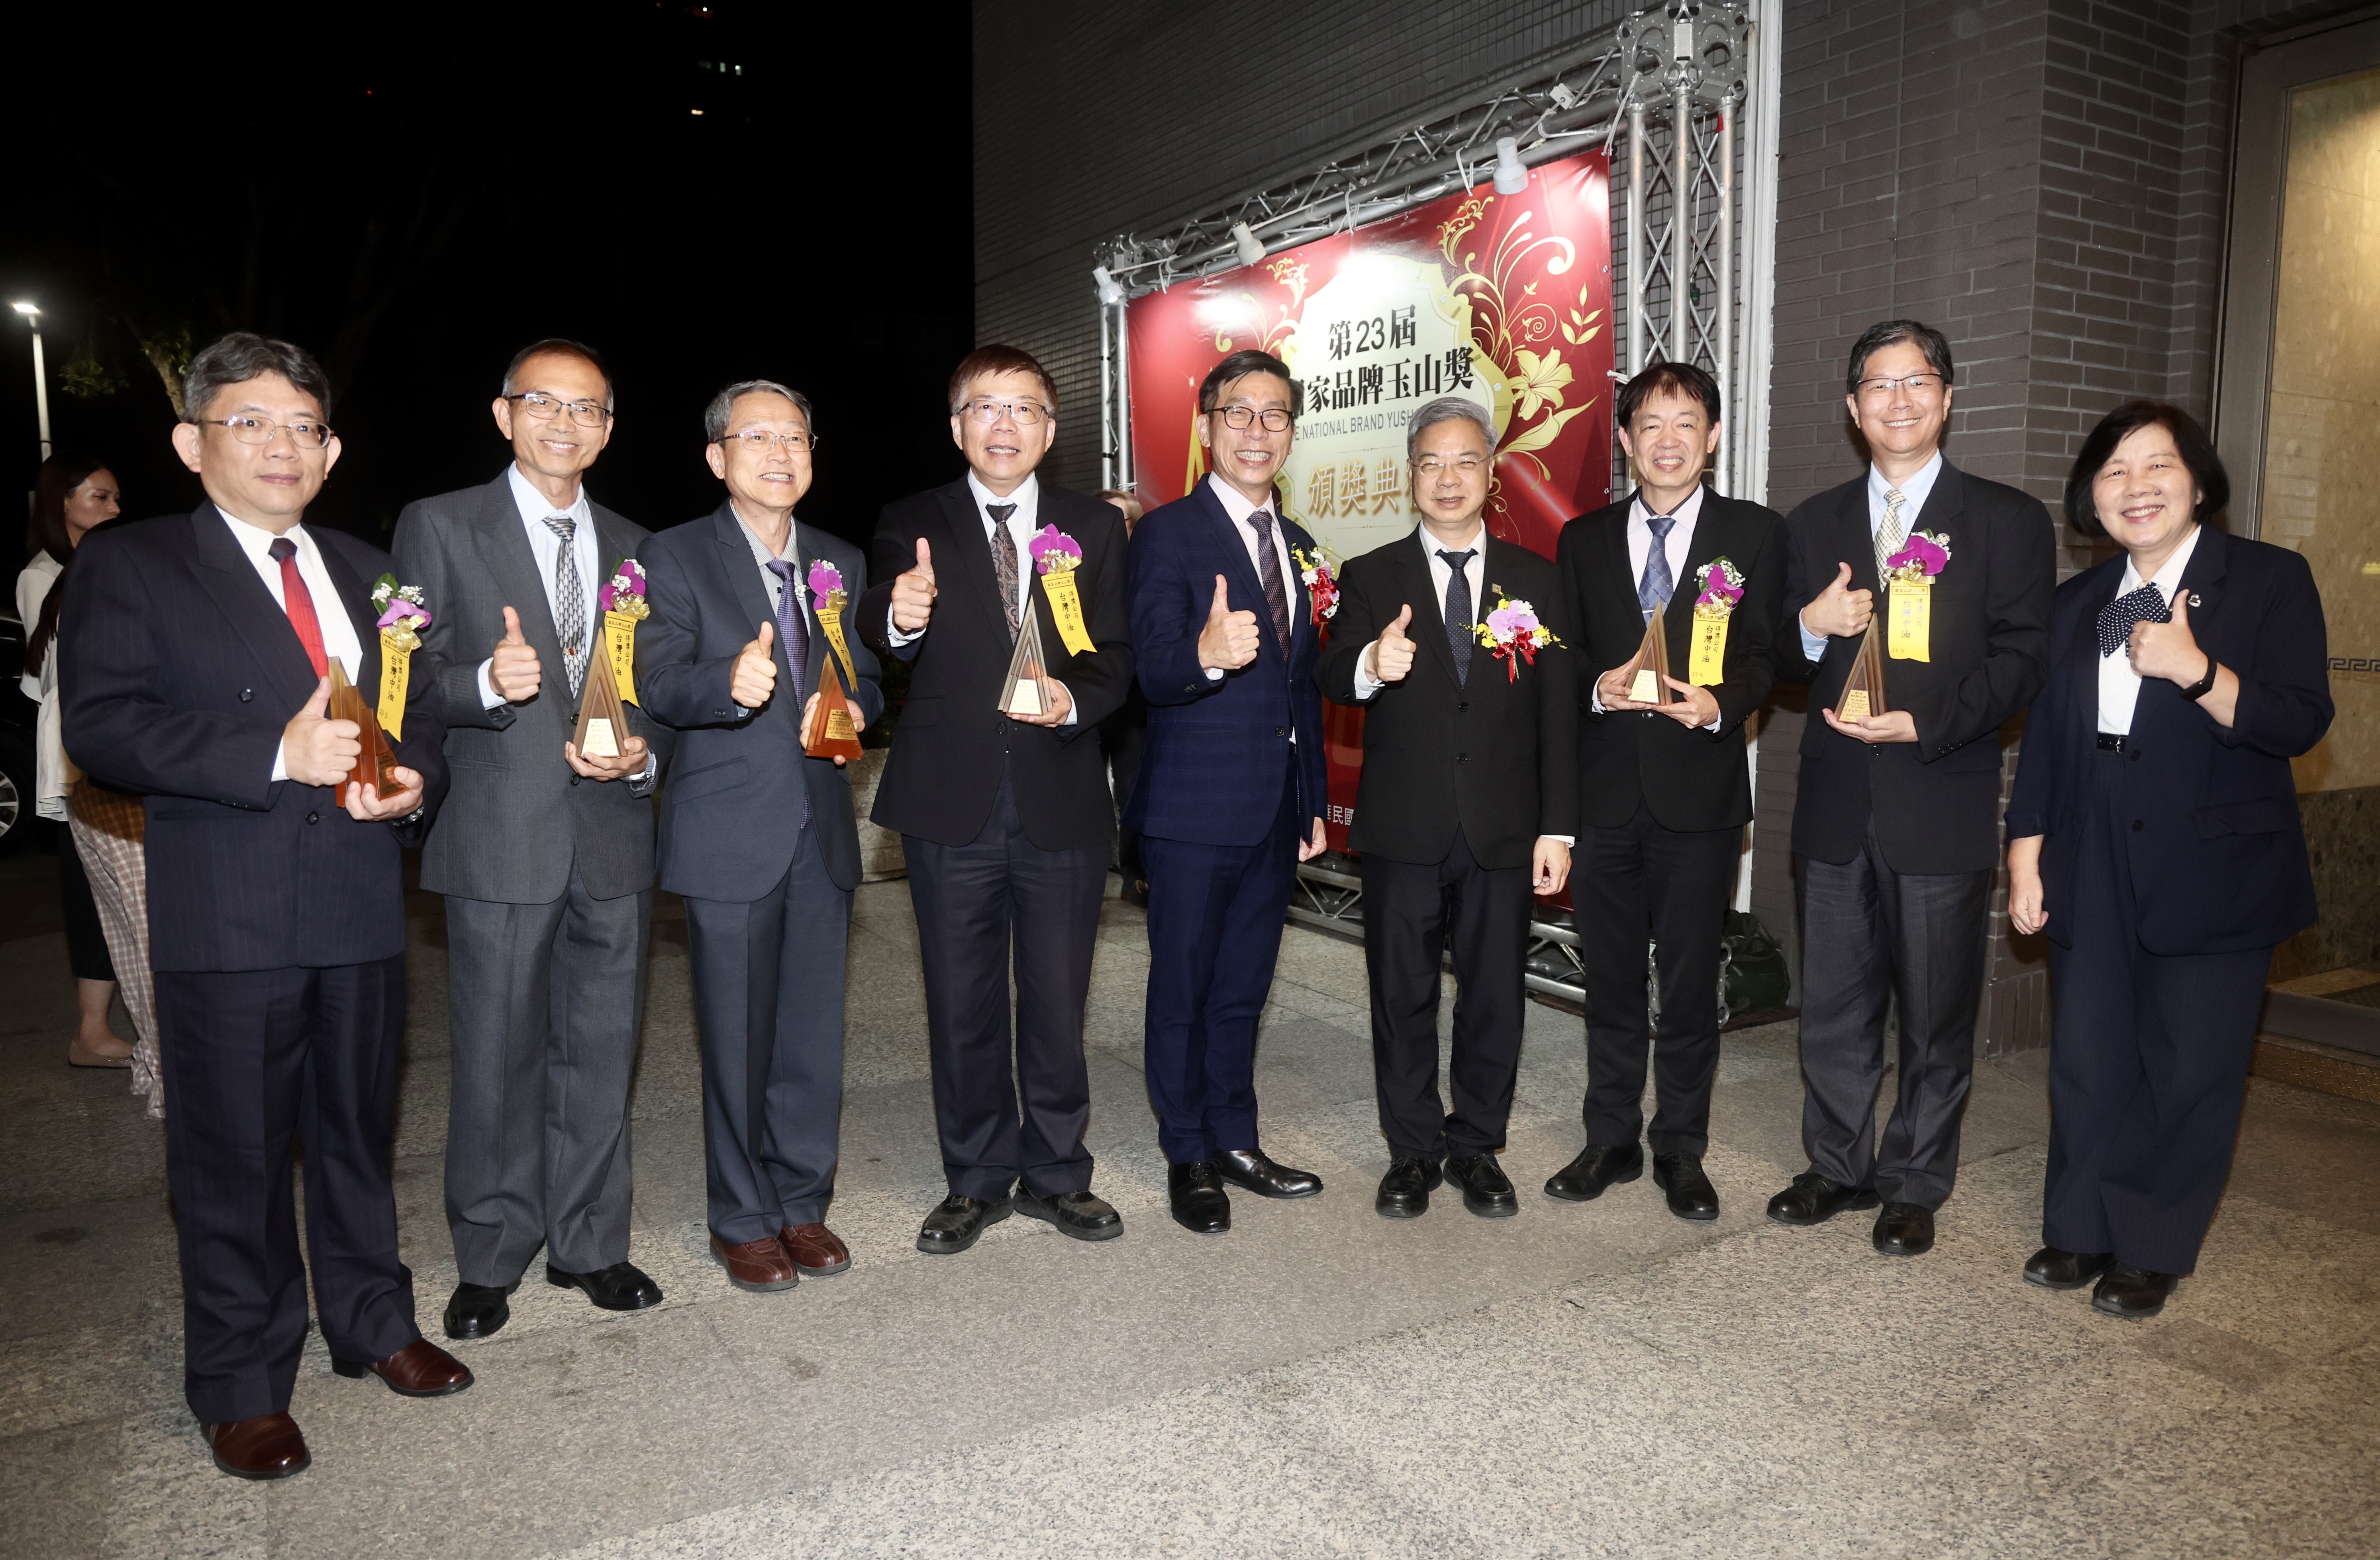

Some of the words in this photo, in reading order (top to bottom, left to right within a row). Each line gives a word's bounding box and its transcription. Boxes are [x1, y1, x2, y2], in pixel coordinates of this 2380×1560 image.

[1328, 304, 1416, 361] 第23屆
[1300, 346, 1474, 416] 家品牌玉山獎
[1303, 419, 1347, 440] NATIONAL
[1351, 414, 1384, 432] BRAND
[1387, 408, 1419, 428] YUSH
[1060, 593, 1074, 632] 台灣中油
[1901, 598, 1911, 638] 台灣中油
[1702, 625, 1713, 663] 台灣中油
[388, 655, 397, 702] 台灣中油
